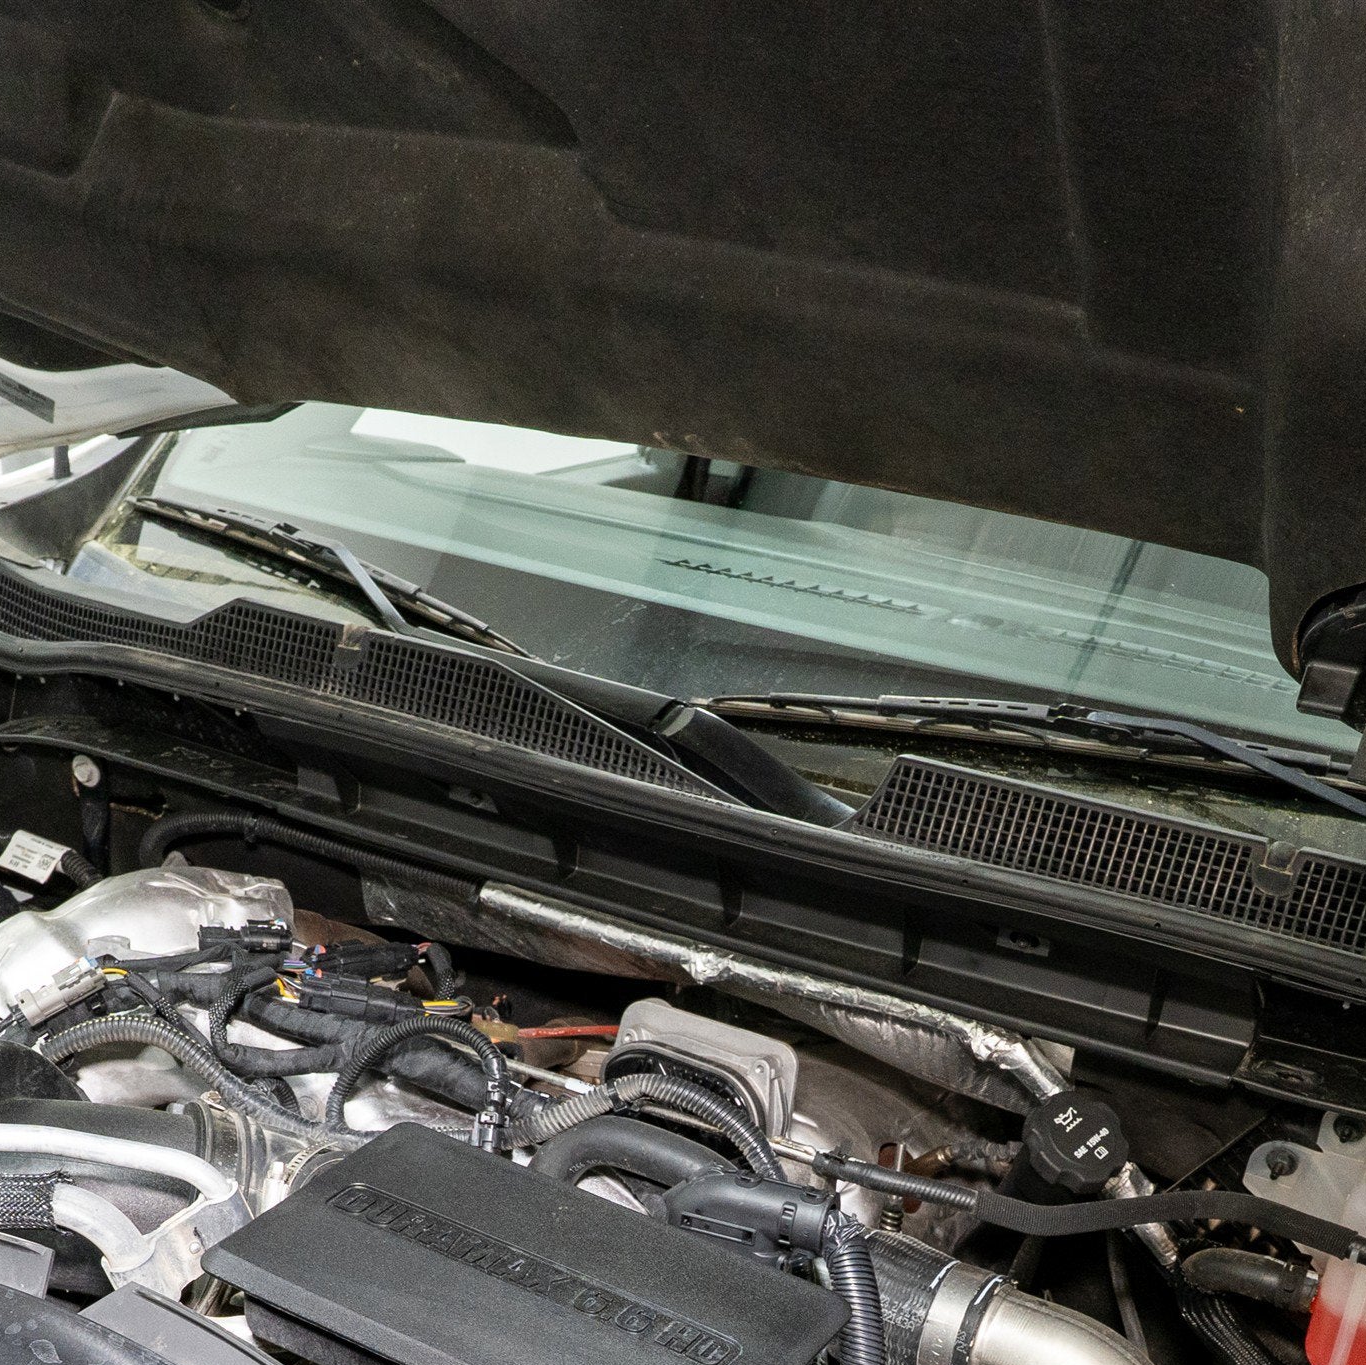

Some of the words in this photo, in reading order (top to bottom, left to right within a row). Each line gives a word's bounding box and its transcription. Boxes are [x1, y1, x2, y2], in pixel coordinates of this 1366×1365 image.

[1074, 1145, 1088, 1159] SAE
[1086, 1127, 1109, 1148] 15W-40
[332, 1189, 570, 1297] DURAMAX
[572, 1287, 656, 1335] 6.6
